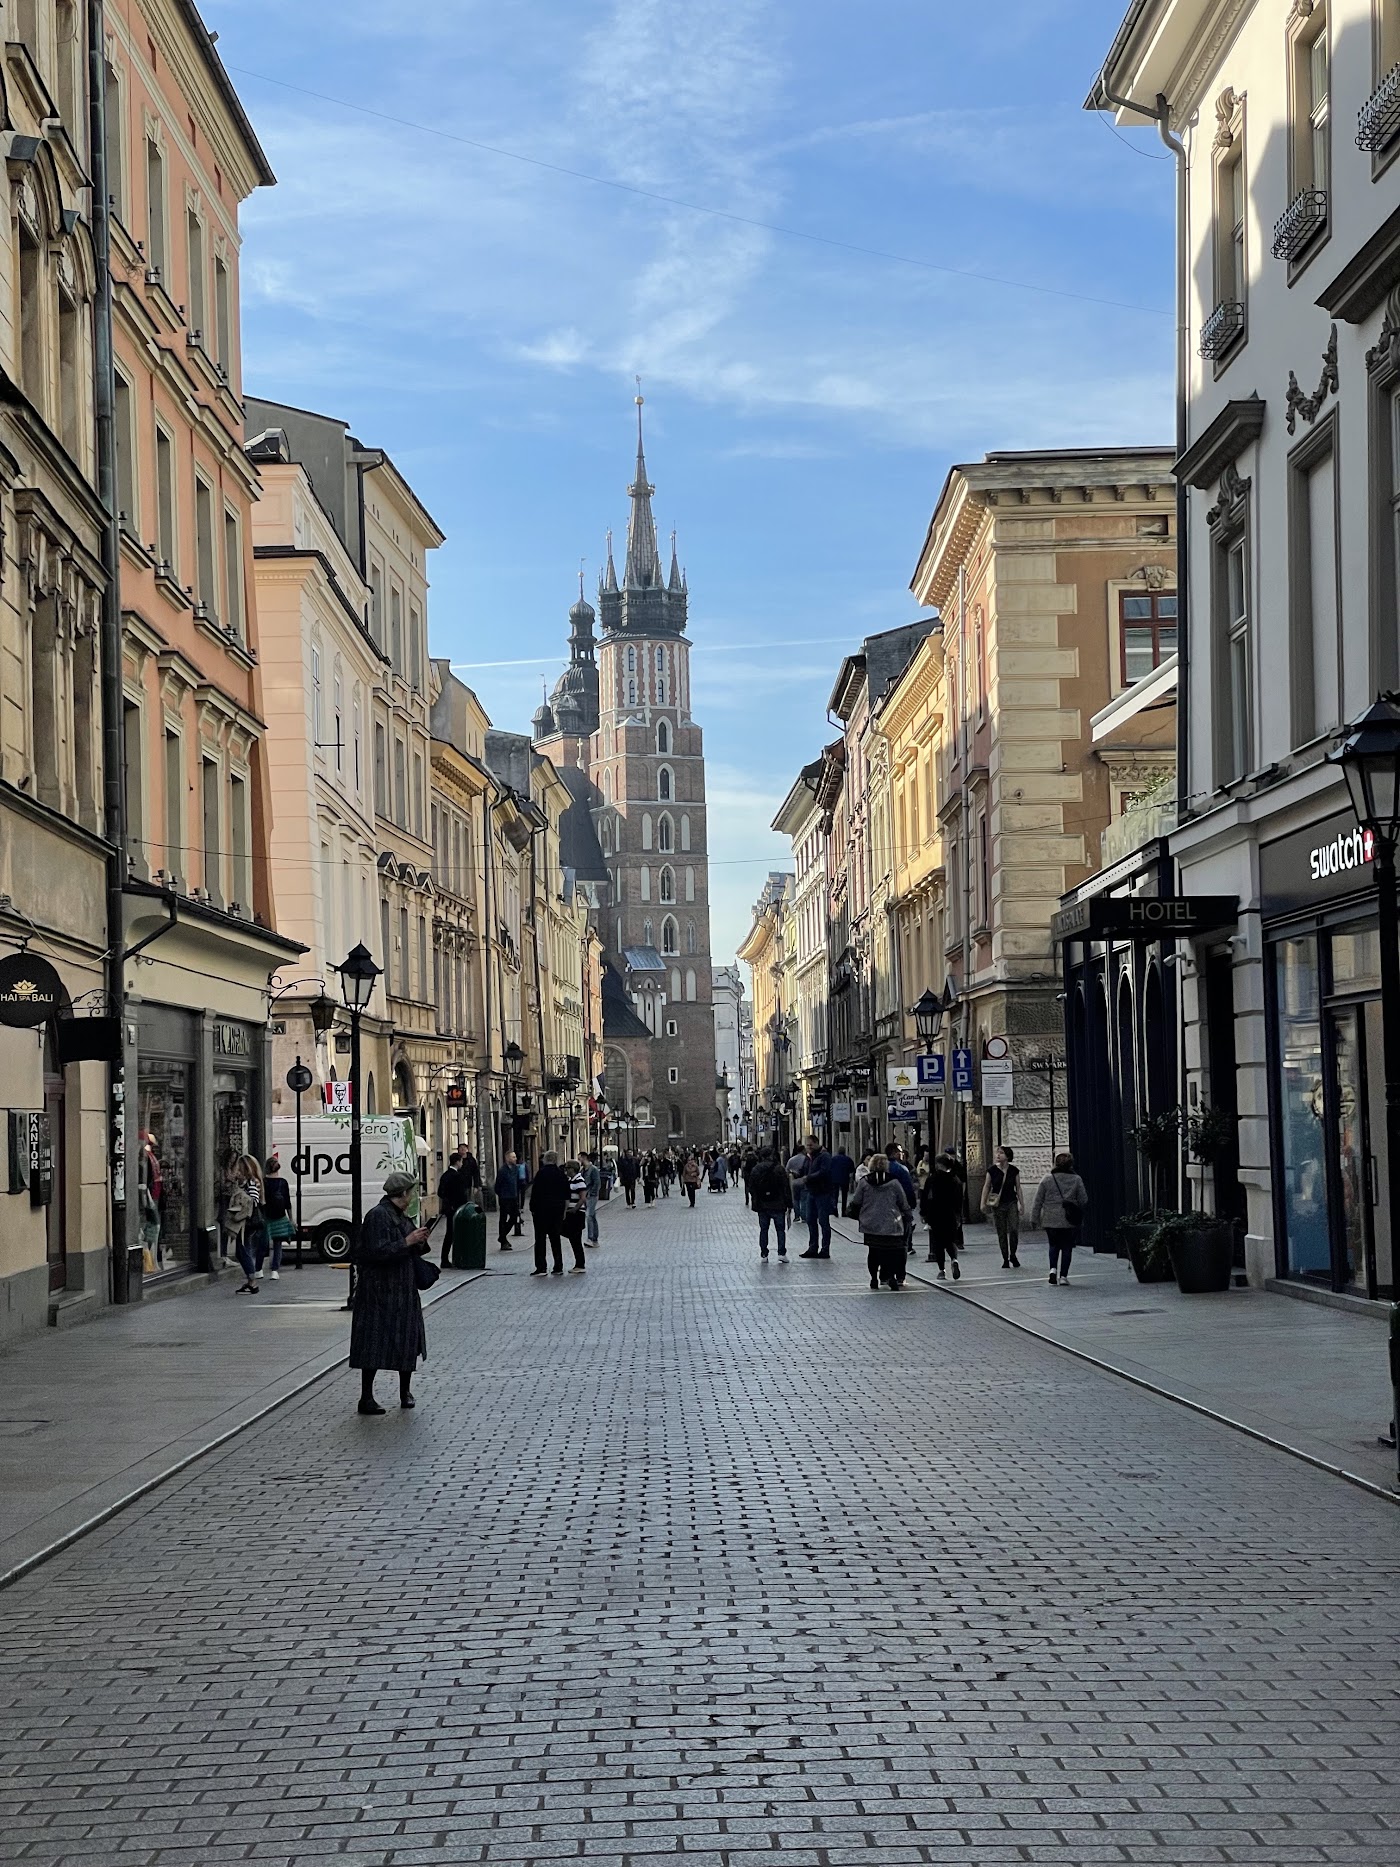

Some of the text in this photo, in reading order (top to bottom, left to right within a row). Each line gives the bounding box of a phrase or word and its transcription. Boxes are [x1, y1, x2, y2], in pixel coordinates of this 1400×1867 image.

[1310, 827, 1364, 880] swatch
[1130, 902, 1197, 920] HOTEL
[0, 993, 18, 1002] HAI
[31, 993, 54, 1002] BALI
[923, 1058, 939, 1080] P
[957, 1071, 969, 1088] P
[331, 1105, 351, 1113] KFC
[30, 1113, 39, 1170] KANTOR
